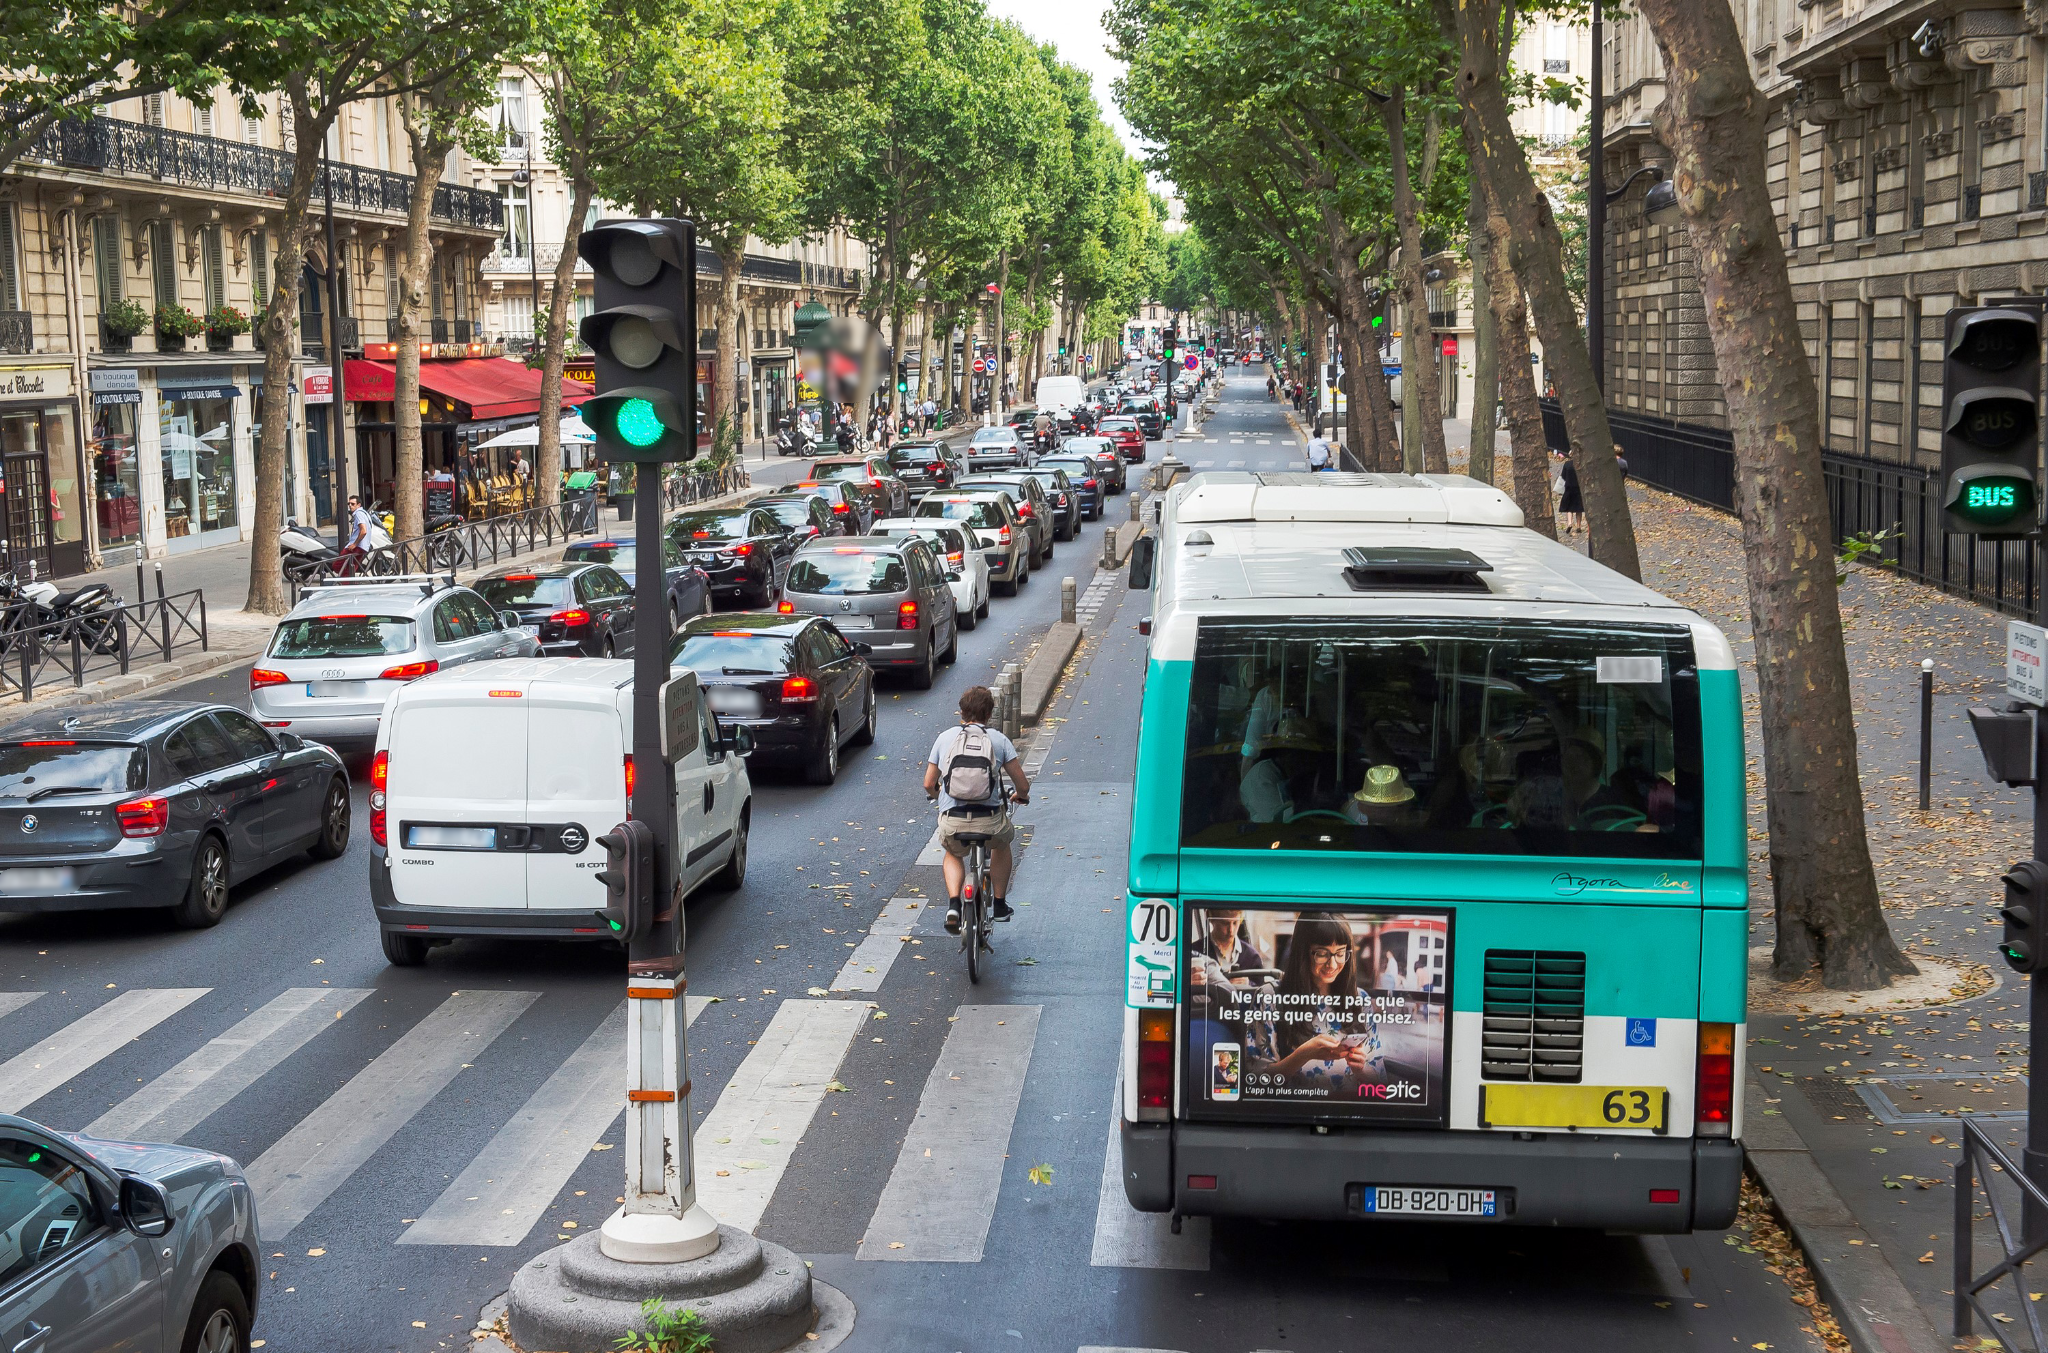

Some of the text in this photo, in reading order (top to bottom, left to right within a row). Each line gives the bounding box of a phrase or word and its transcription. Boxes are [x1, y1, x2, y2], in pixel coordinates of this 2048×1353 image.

[7, 378, 14, 394] et
[15, 374, 45, 394] Chocolat
[103, 373, 135, 382] boutique
[563, 370, 595, 380] ICOLA
[1974, 411, 2016, 432] BUS
[1969, 486, 2014, 507] BUS
[672, 700, 693, 720] ATTENTION
[1551, 872, 1694, 897] Agora line
[1140, 904, 1171, 942] 70
[1231, 990, 1405, 1012] Ne rencontrez pas que
[1219, 1007, 1416, 1025] les gens que vous croisez.
[1245, 1086, 1329, 1096] L'app la plus complète
[1358, 1080, 1421, 1100] meetic
[1602, 1090, 1651, 1124] 63
[1378, 1189, 1482, 1212] DB-920-DH
[1484, 1204, 1494, 1214] 75
